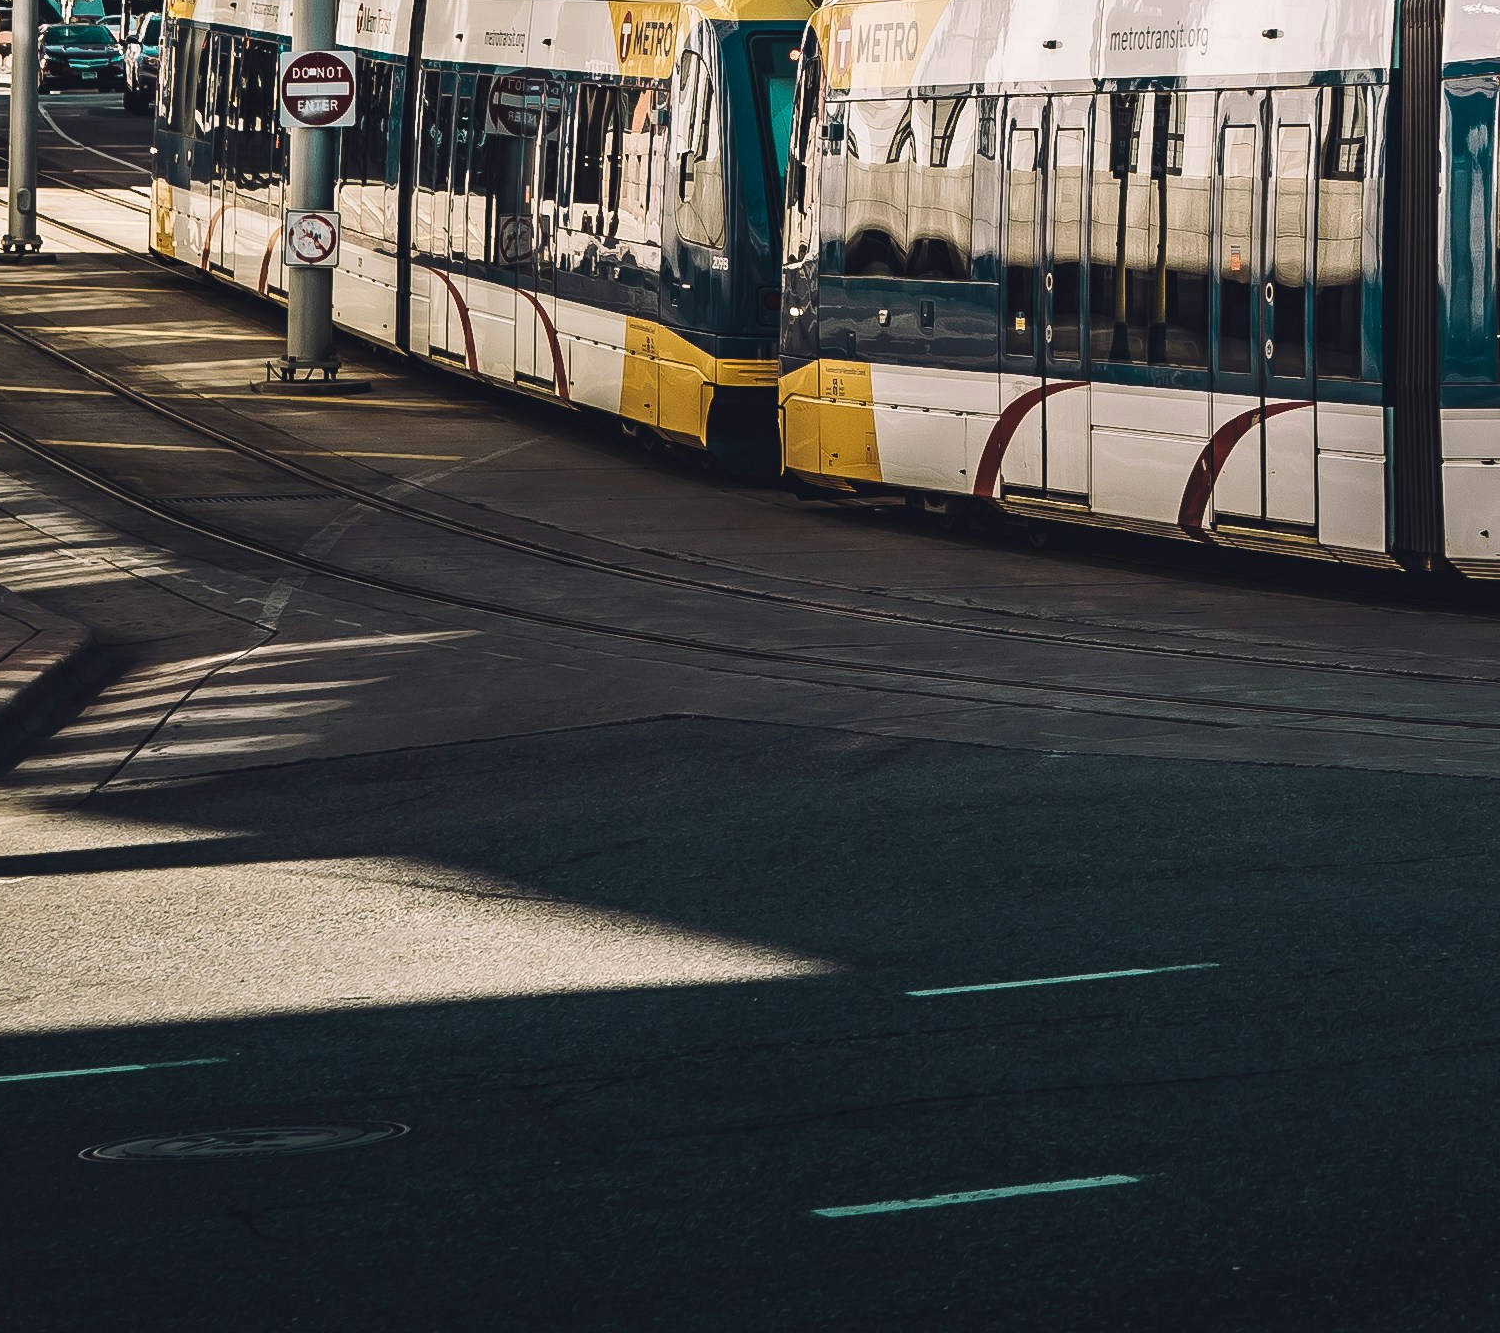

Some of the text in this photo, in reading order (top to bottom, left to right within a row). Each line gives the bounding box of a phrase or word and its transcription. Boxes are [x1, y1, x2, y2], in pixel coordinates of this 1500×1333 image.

[632, 21, 673, 57] METRO
[857, 21, 918, 64] METRO
[1109, 20, 1209, 56] metrotransit.org
[292, 66, 344, 79] DO NOT
[297, 99, 339, 112] ENTER
